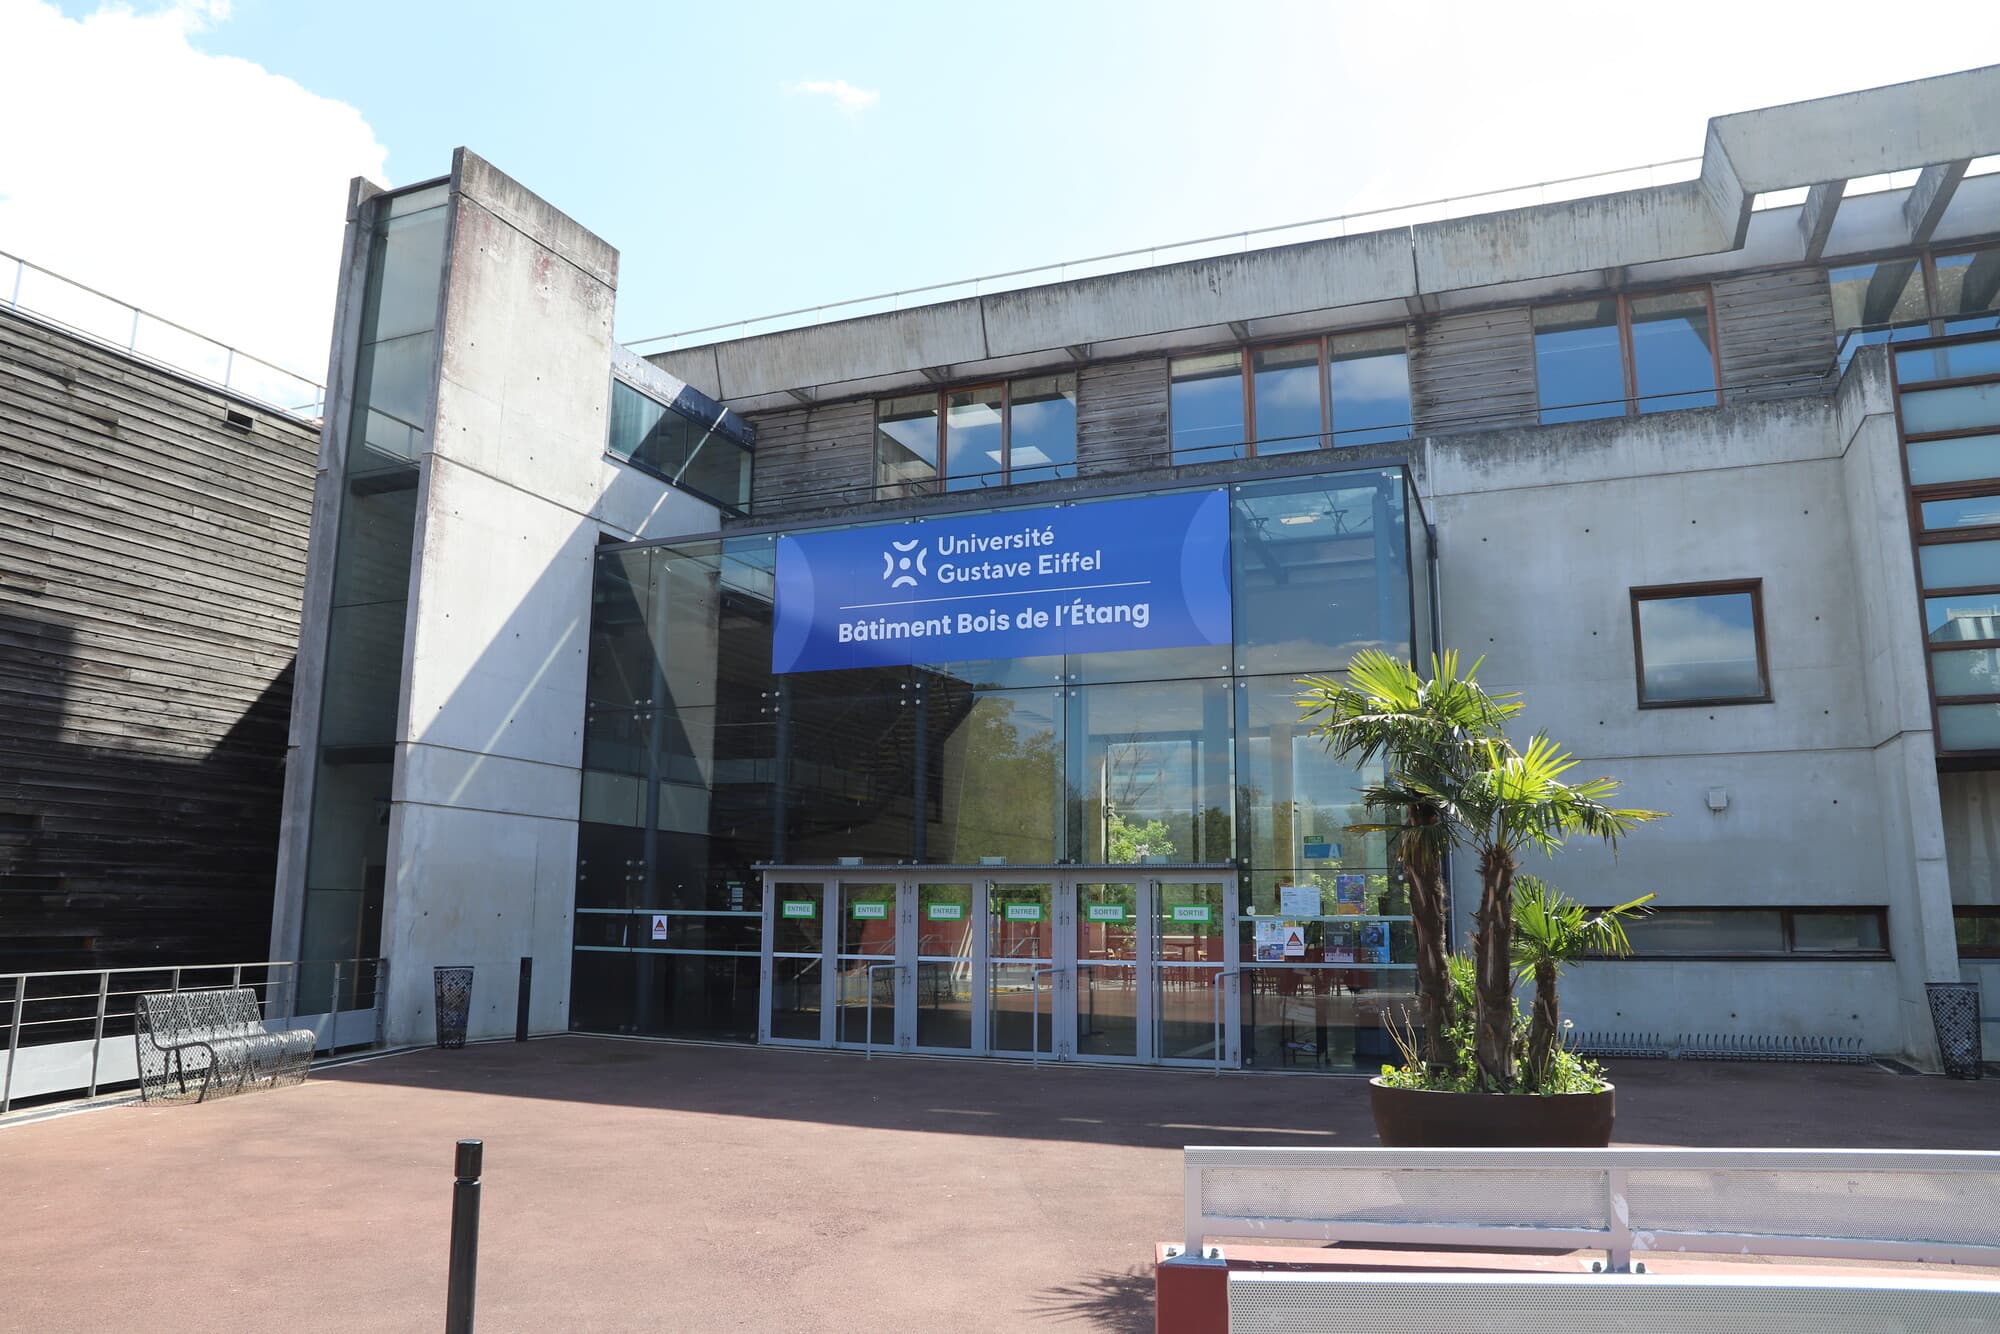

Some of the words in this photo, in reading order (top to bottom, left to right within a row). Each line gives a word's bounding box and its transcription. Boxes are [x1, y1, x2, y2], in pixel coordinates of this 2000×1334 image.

[938, 525, 1055, 556] Université
[937, 562, 1031, 584] Gustave
[1038, 549, 1101, 575] Eiffel
[838, 615, 952, 643] Bâtiment
[957, 608, 1010, 634] Bois
[1016, 607, 1049, 629] de
[1055, 598, 1150, 629] l'Étang
[1093, 908, 1121, 916] SORTIE
[1178, 909, 1204, 917] SORTIE
